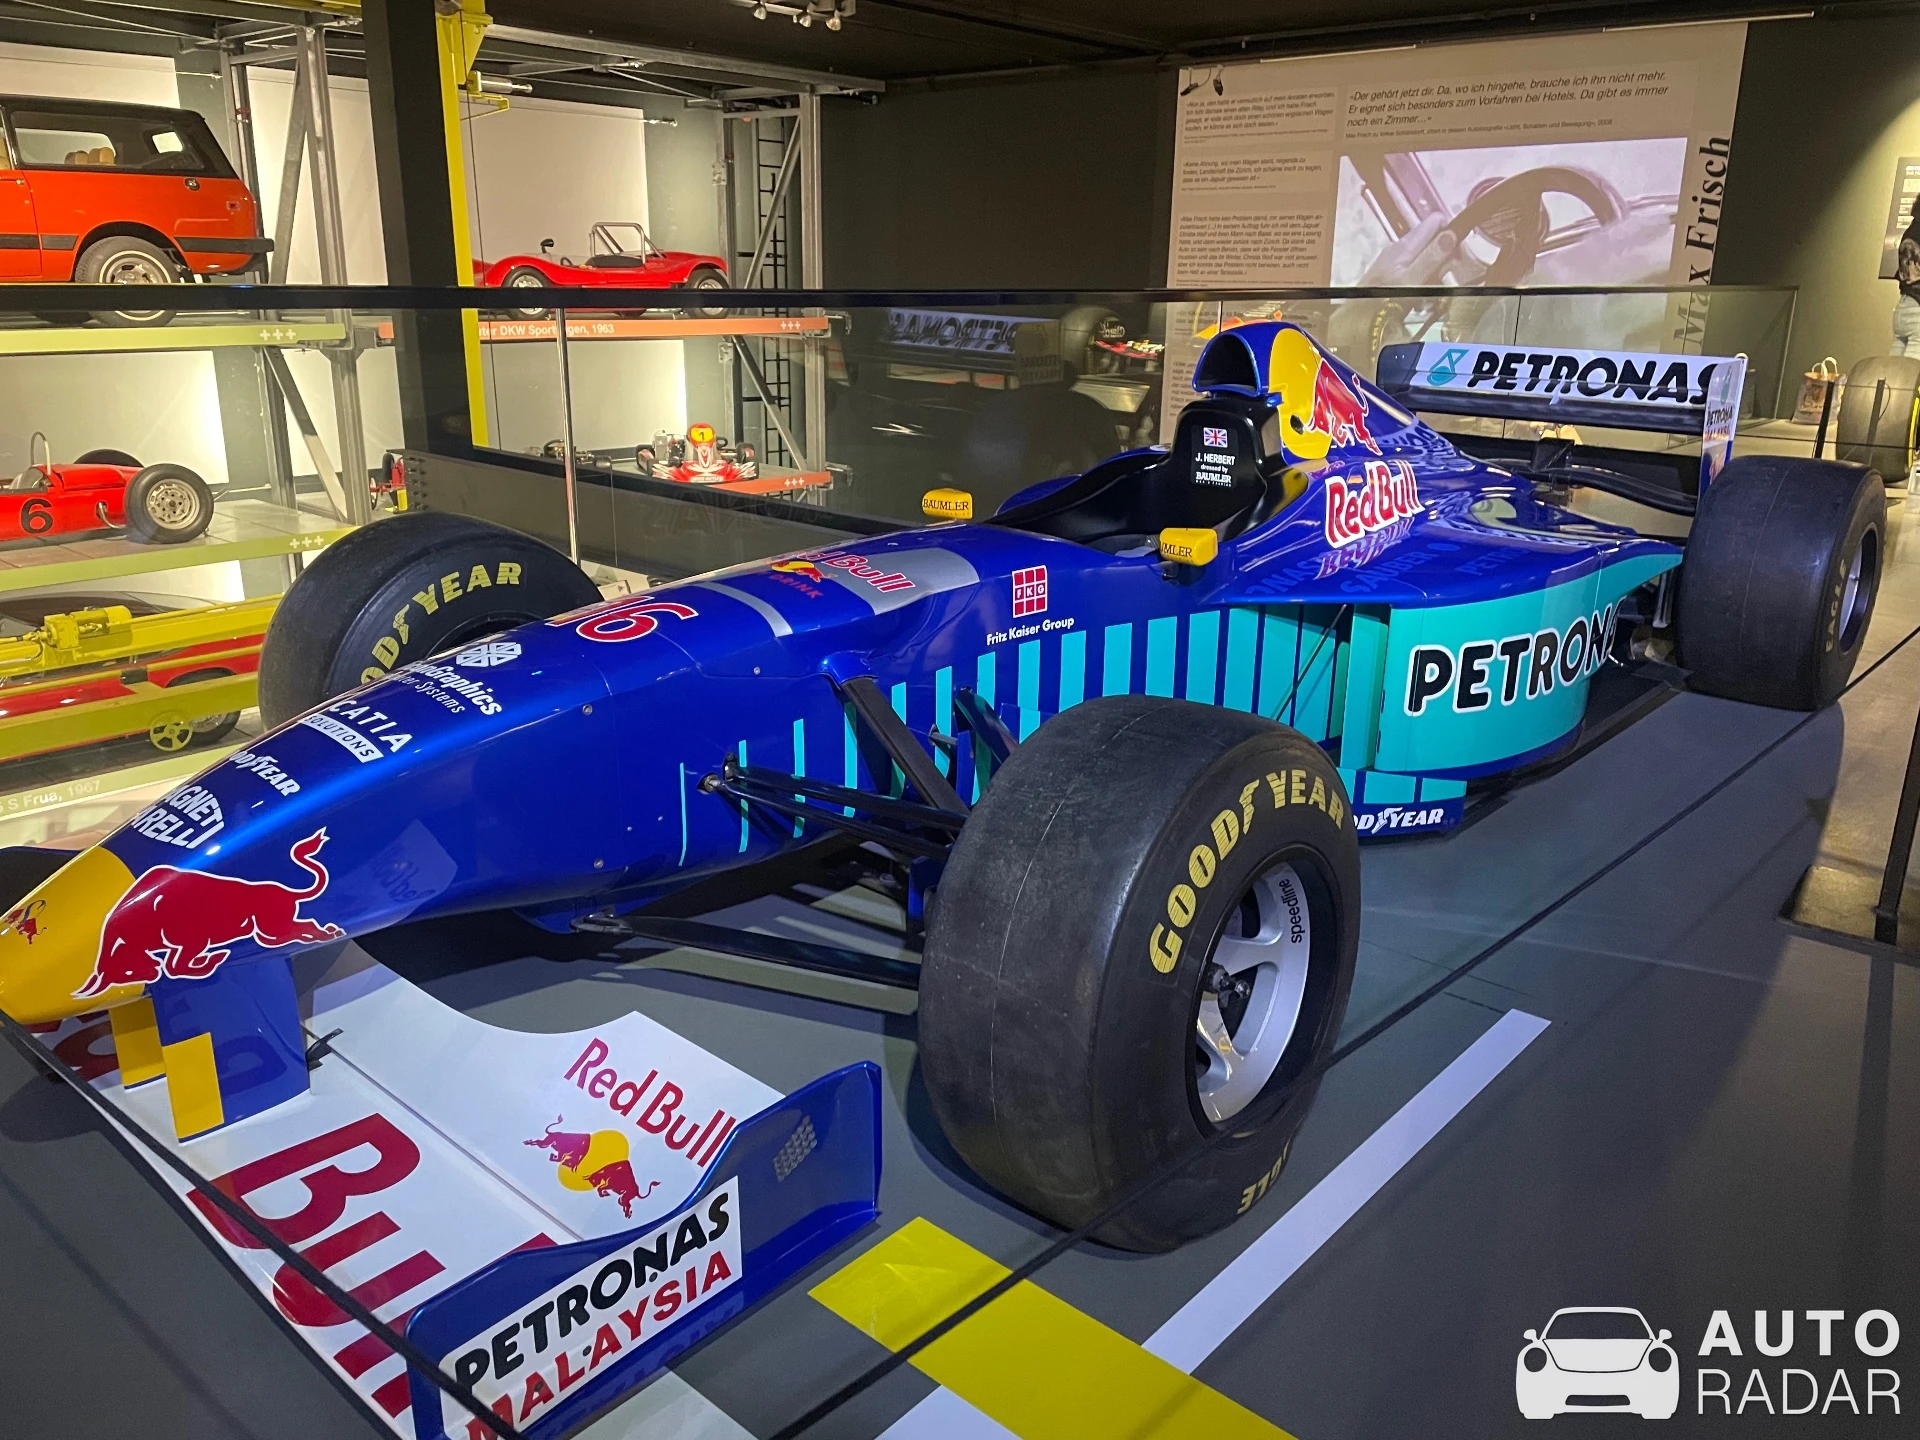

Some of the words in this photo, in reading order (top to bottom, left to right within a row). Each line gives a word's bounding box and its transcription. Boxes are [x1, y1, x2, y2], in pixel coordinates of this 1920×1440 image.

[1348, 105, 1359, 114] Er
[1360, 103, 1386, 115] eignet
[1387, 101, 1405, 112] sich
[1407, 99, 1453, 111] besonders
[1456, 98, 1476, 107] zum
[1479, 95, 1522, 106] Vorfahren
[1525, 94, 1540, 104] bei
[1542, 91, 1576, 102] Hotels.
[1580, 89, 1595, 99] Da
[1597, 88, 1617, 101] gibt
[1619, 88, 1632, 97] es
[1634, 86, 1669, 96] immer
[1371, 90, 1399, 102] gehört
[1399, 88, 1420, 99] jetzt
[1421, 87, 1434, 97] dir.
[1437, 85, 1451, 95] Da,
[1455, 86, 1469, 94] wo
[1471, 83, 1485, 93] ich
[1488, 80, 1526, 93] hingehe,
[1530, 77, 1570, 89] brauche
[1572, 76, 1588, 86] ich
[1590, 75, 1606, 85] ihn
[1608, 72, 1635, 84] nicht
[1637, 70, 1666, 82] mehr.
[1347, 116, 1367, 126] noch
[1370, 117, 1383, 126] ein
[1685, 137, 1731, 251] Frisch
[500, 324, 527, 336] DKW
[528, 323, 590, 337] Sportgen,
[593, 321, 615, 335] 1963
[698, 431, 705, 442] 1
[1195, 452, 1203, 462] J.
[1204, 453, 1236, 466] HERBERT
[1200, 463, 1221, 471] dressed
[1222, 466, 1229, 474] by
[21, 498, 53, 534] 6
[1326, 462, 1377, 546] Red
[1376, 460, 1424, 521] Bull
[1161, 541, 1194, 558] MLER
[822, 555, 916, 593] Bull
[545, 595, 699, 643] 16
[986, 631, 1008, 646] Fritz
[1009, 623, 1041, 641] Kaiser
[1042, 617, 1075, 632] Group
[1404, 604, 1615, 716] PETRON
[414, 681, 466, 714] Systems
[305, 714, 376, 758] SOLUTIONS
[328, 700, 413, 753] CATIA
[8, 798, 19, 810] S
[23, 789, 63, 808] Frua,
[67, 780, 101, 797] 1967
[1149, 770, 1344, 974] GOODYEAR
[1280, 879, 1302, 943] speedline
[564, 1037, 659, 1118] Red
[636, 1080, 737, 1168] Bull
[455, 1192, 729, 1396] PETRONAS
